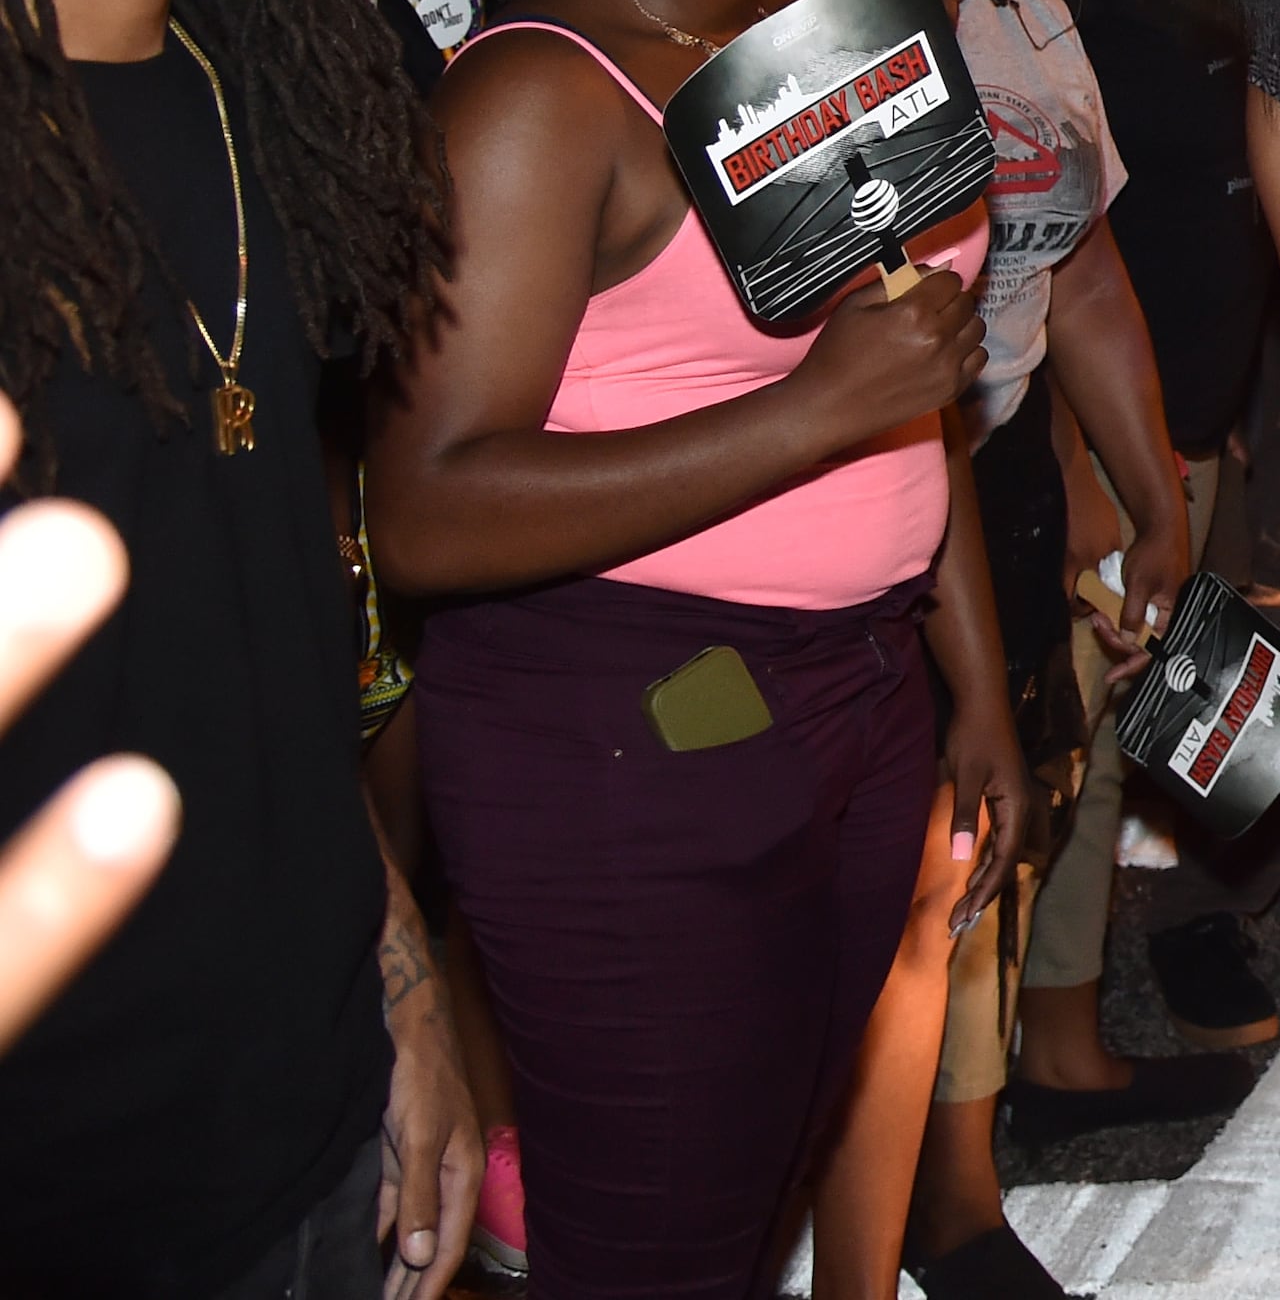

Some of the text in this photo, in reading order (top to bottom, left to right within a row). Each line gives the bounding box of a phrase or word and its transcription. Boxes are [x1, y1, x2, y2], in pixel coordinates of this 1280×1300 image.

[723, 43, 931, 194] BIRTHDAY BASH
[890, 90, 940, 130] ATL
[1174, 726, 1202, 764] ATL
[1187, 728, 1233, 789] BASH
